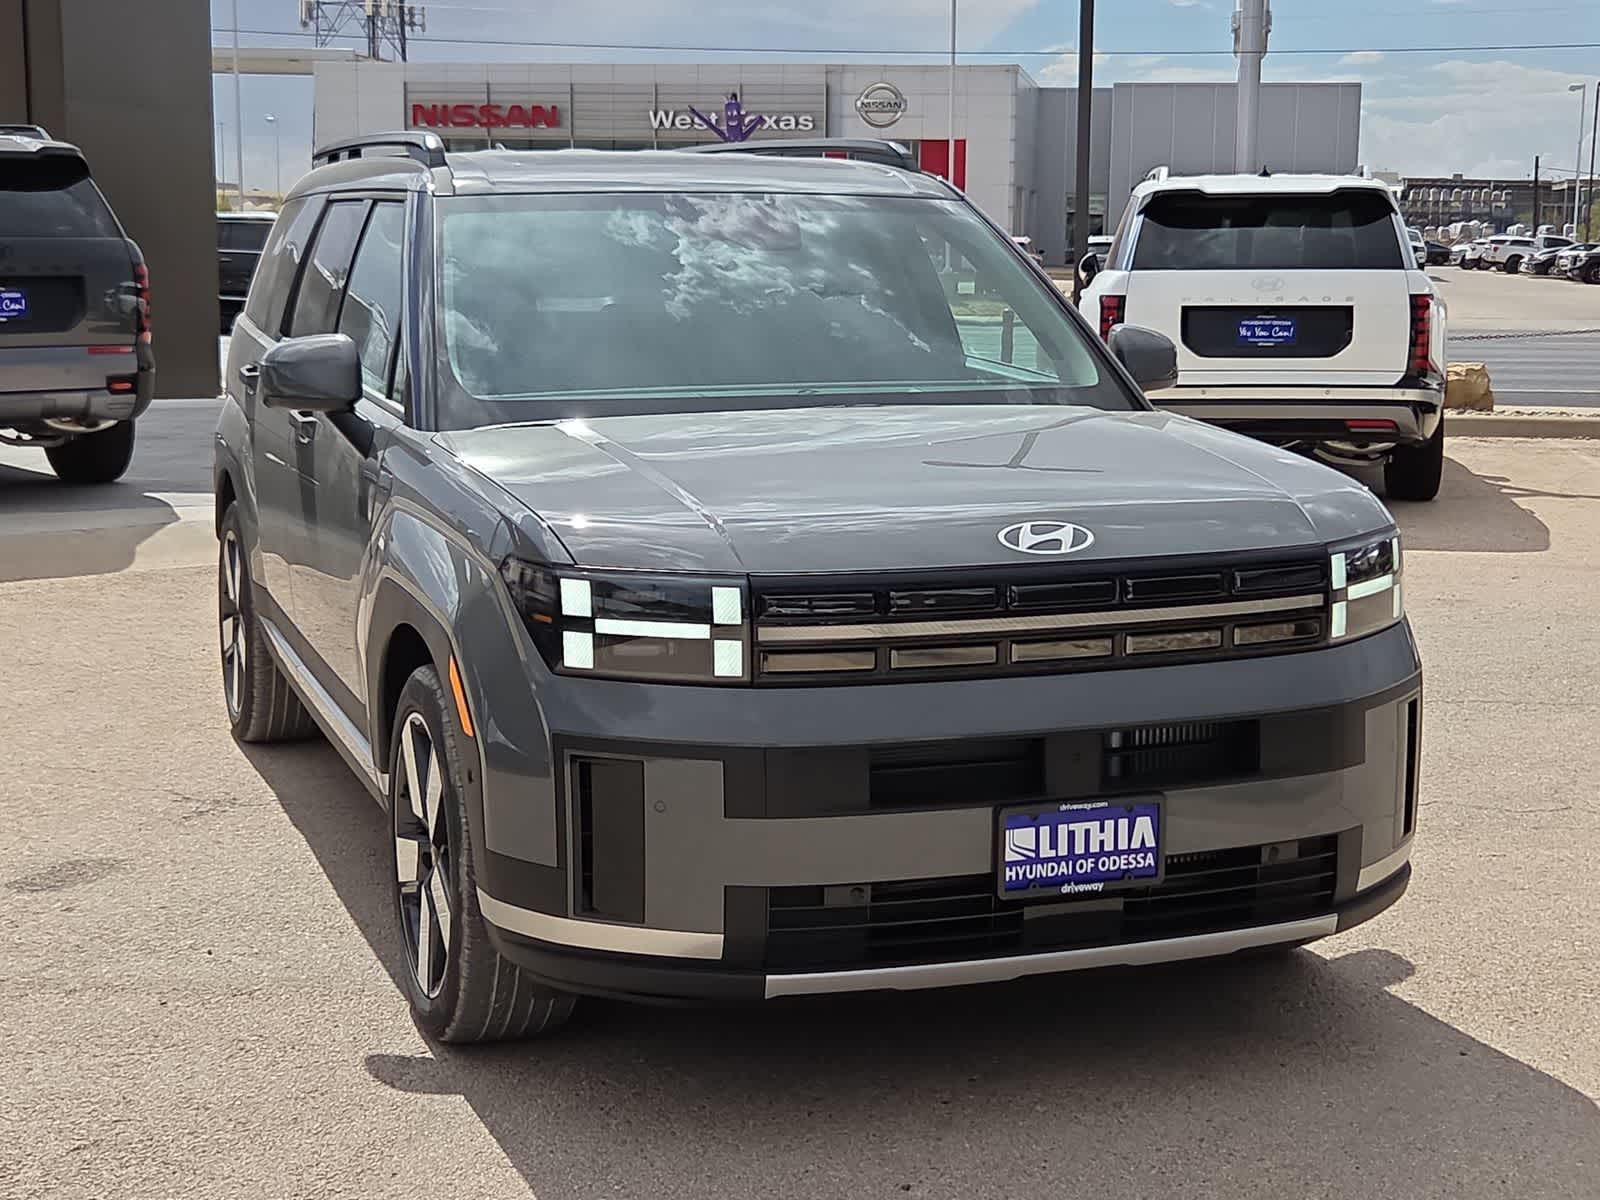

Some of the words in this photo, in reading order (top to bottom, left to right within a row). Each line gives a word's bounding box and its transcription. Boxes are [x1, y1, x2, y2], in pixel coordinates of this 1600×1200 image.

[859, 100, 902, 111] NISSAN
[412, 104, 559, 128] NISSAN
[741, 110, 816, 131] exas
[1254, 327, 1270, 337] You
[1059, 801, 1108, 812] driveway.com
[1039, 816, 1156, 858] LITHIA
[1005, 860, 1072, 882] HYUNDAI
[1075, 858, 1095, 873] OF
[1098, 852, 1155, 872] ODESSA
[1060, 881, 1104, 894] driveway
